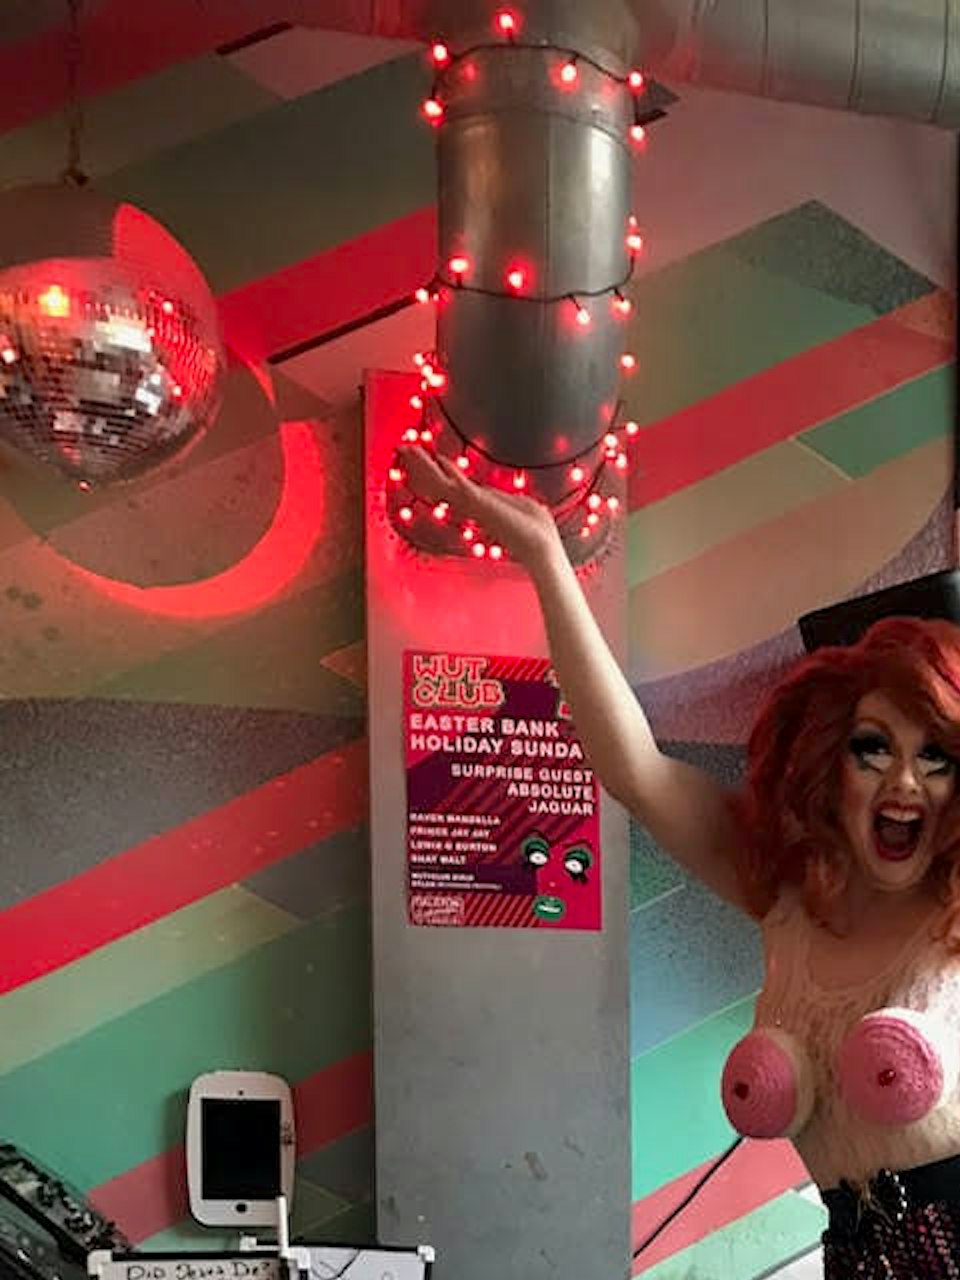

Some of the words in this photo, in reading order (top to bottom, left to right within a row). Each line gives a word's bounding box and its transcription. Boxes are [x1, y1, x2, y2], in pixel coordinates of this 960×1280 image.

[414, 678, 505, 708] CLUB
[410, 713, 495, 733] EASTER
[501, 718, 560, 738] BANK
[410, 734, 503, 754] HOLIDAY
[511, 739, 584, 760] SUNDA
[451, 763, 534, 781] SURPRISE
[539, 767, 594, 783] GUEST
[507, 783, 594, 802] ABSOLUTE
[528, 800, 594, 816] JAGUAR
